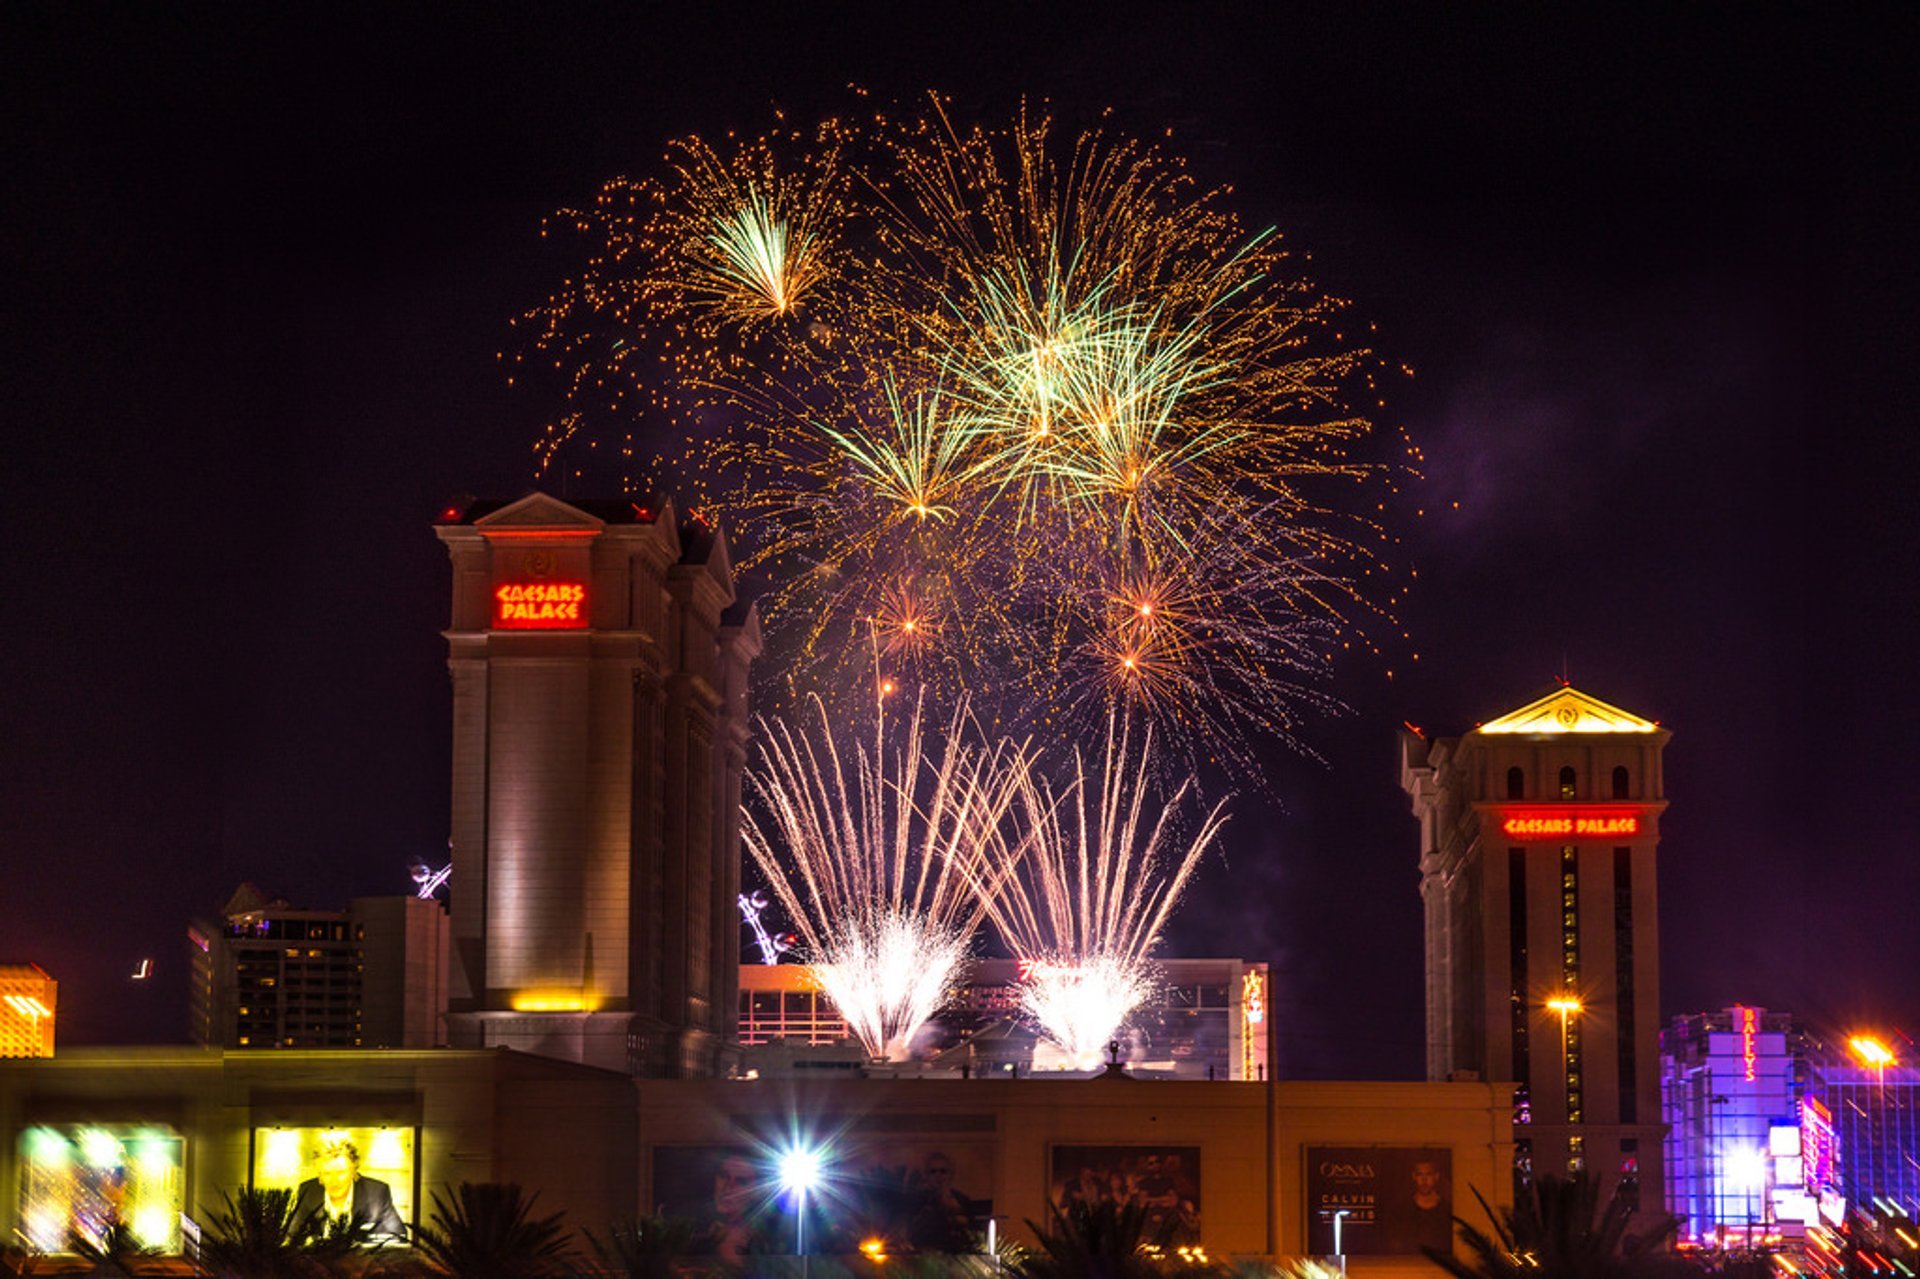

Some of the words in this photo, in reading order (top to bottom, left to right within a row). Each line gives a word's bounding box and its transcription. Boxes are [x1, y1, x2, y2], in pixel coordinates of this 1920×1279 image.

[497, 585, 584, 602] CAESARS
[502, 603, 578, 619] PALACE
[1504, 819, 1573, 833] CAESARS
[1576, 819, 1636, 833] PALACE
[1322, 1194, 1375, 1204] CALVIN
